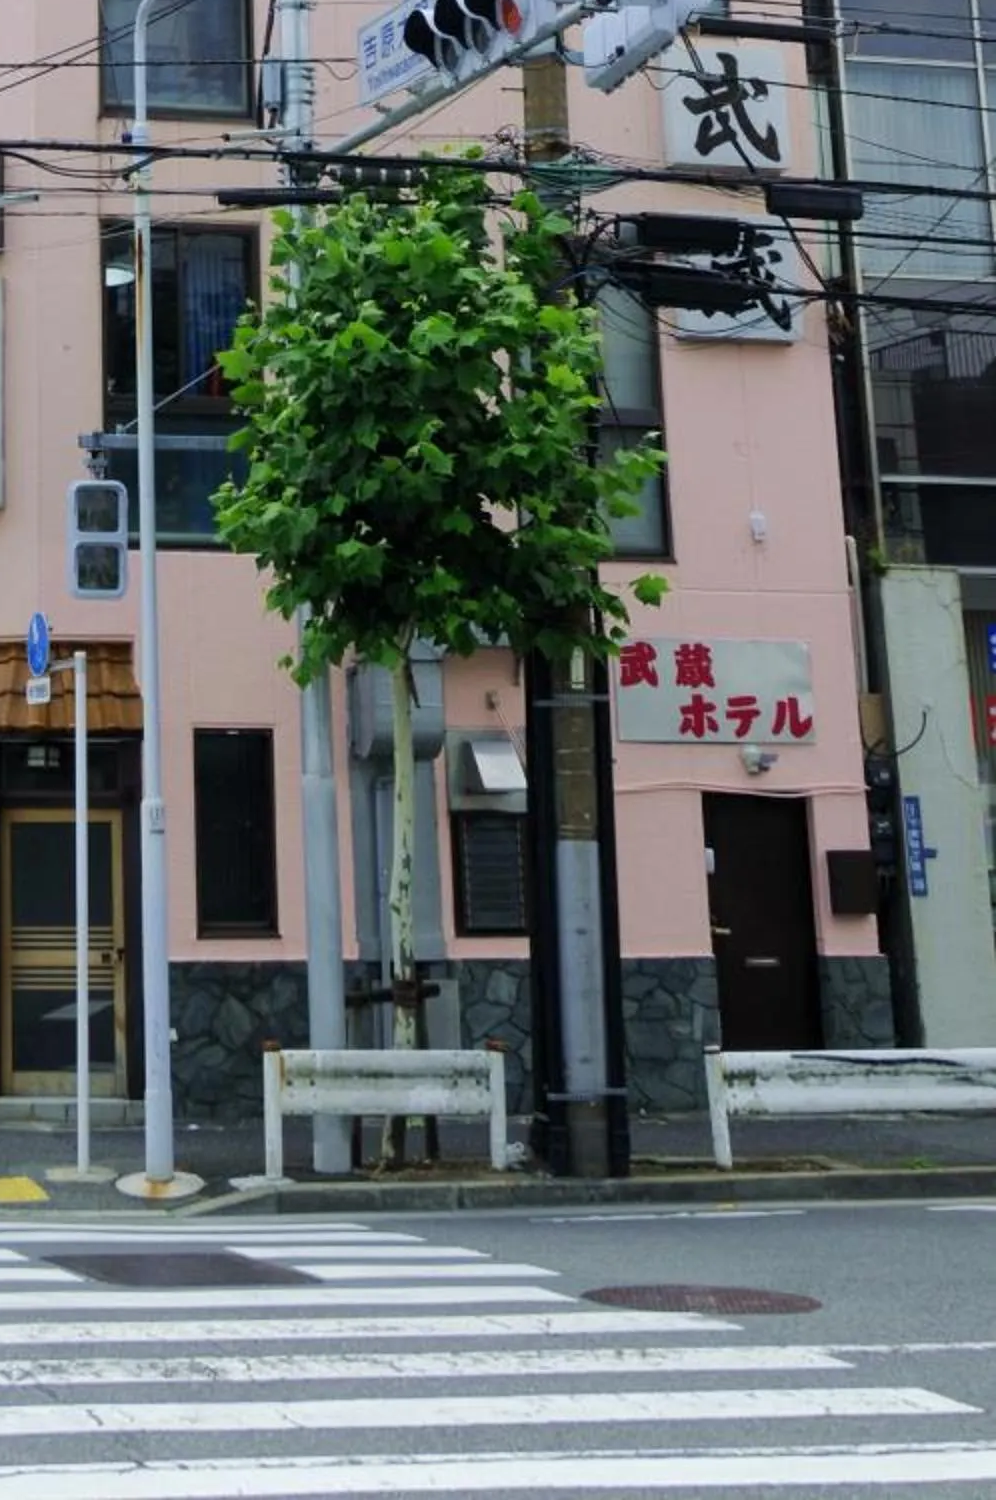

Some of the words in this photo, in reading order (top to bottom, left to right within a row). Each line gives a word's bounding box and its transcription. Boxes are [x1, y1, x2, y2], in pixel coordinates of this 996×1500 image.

[619, 641, 716, 689] 武蔵
[679, 694, 813, 739] ホテル
